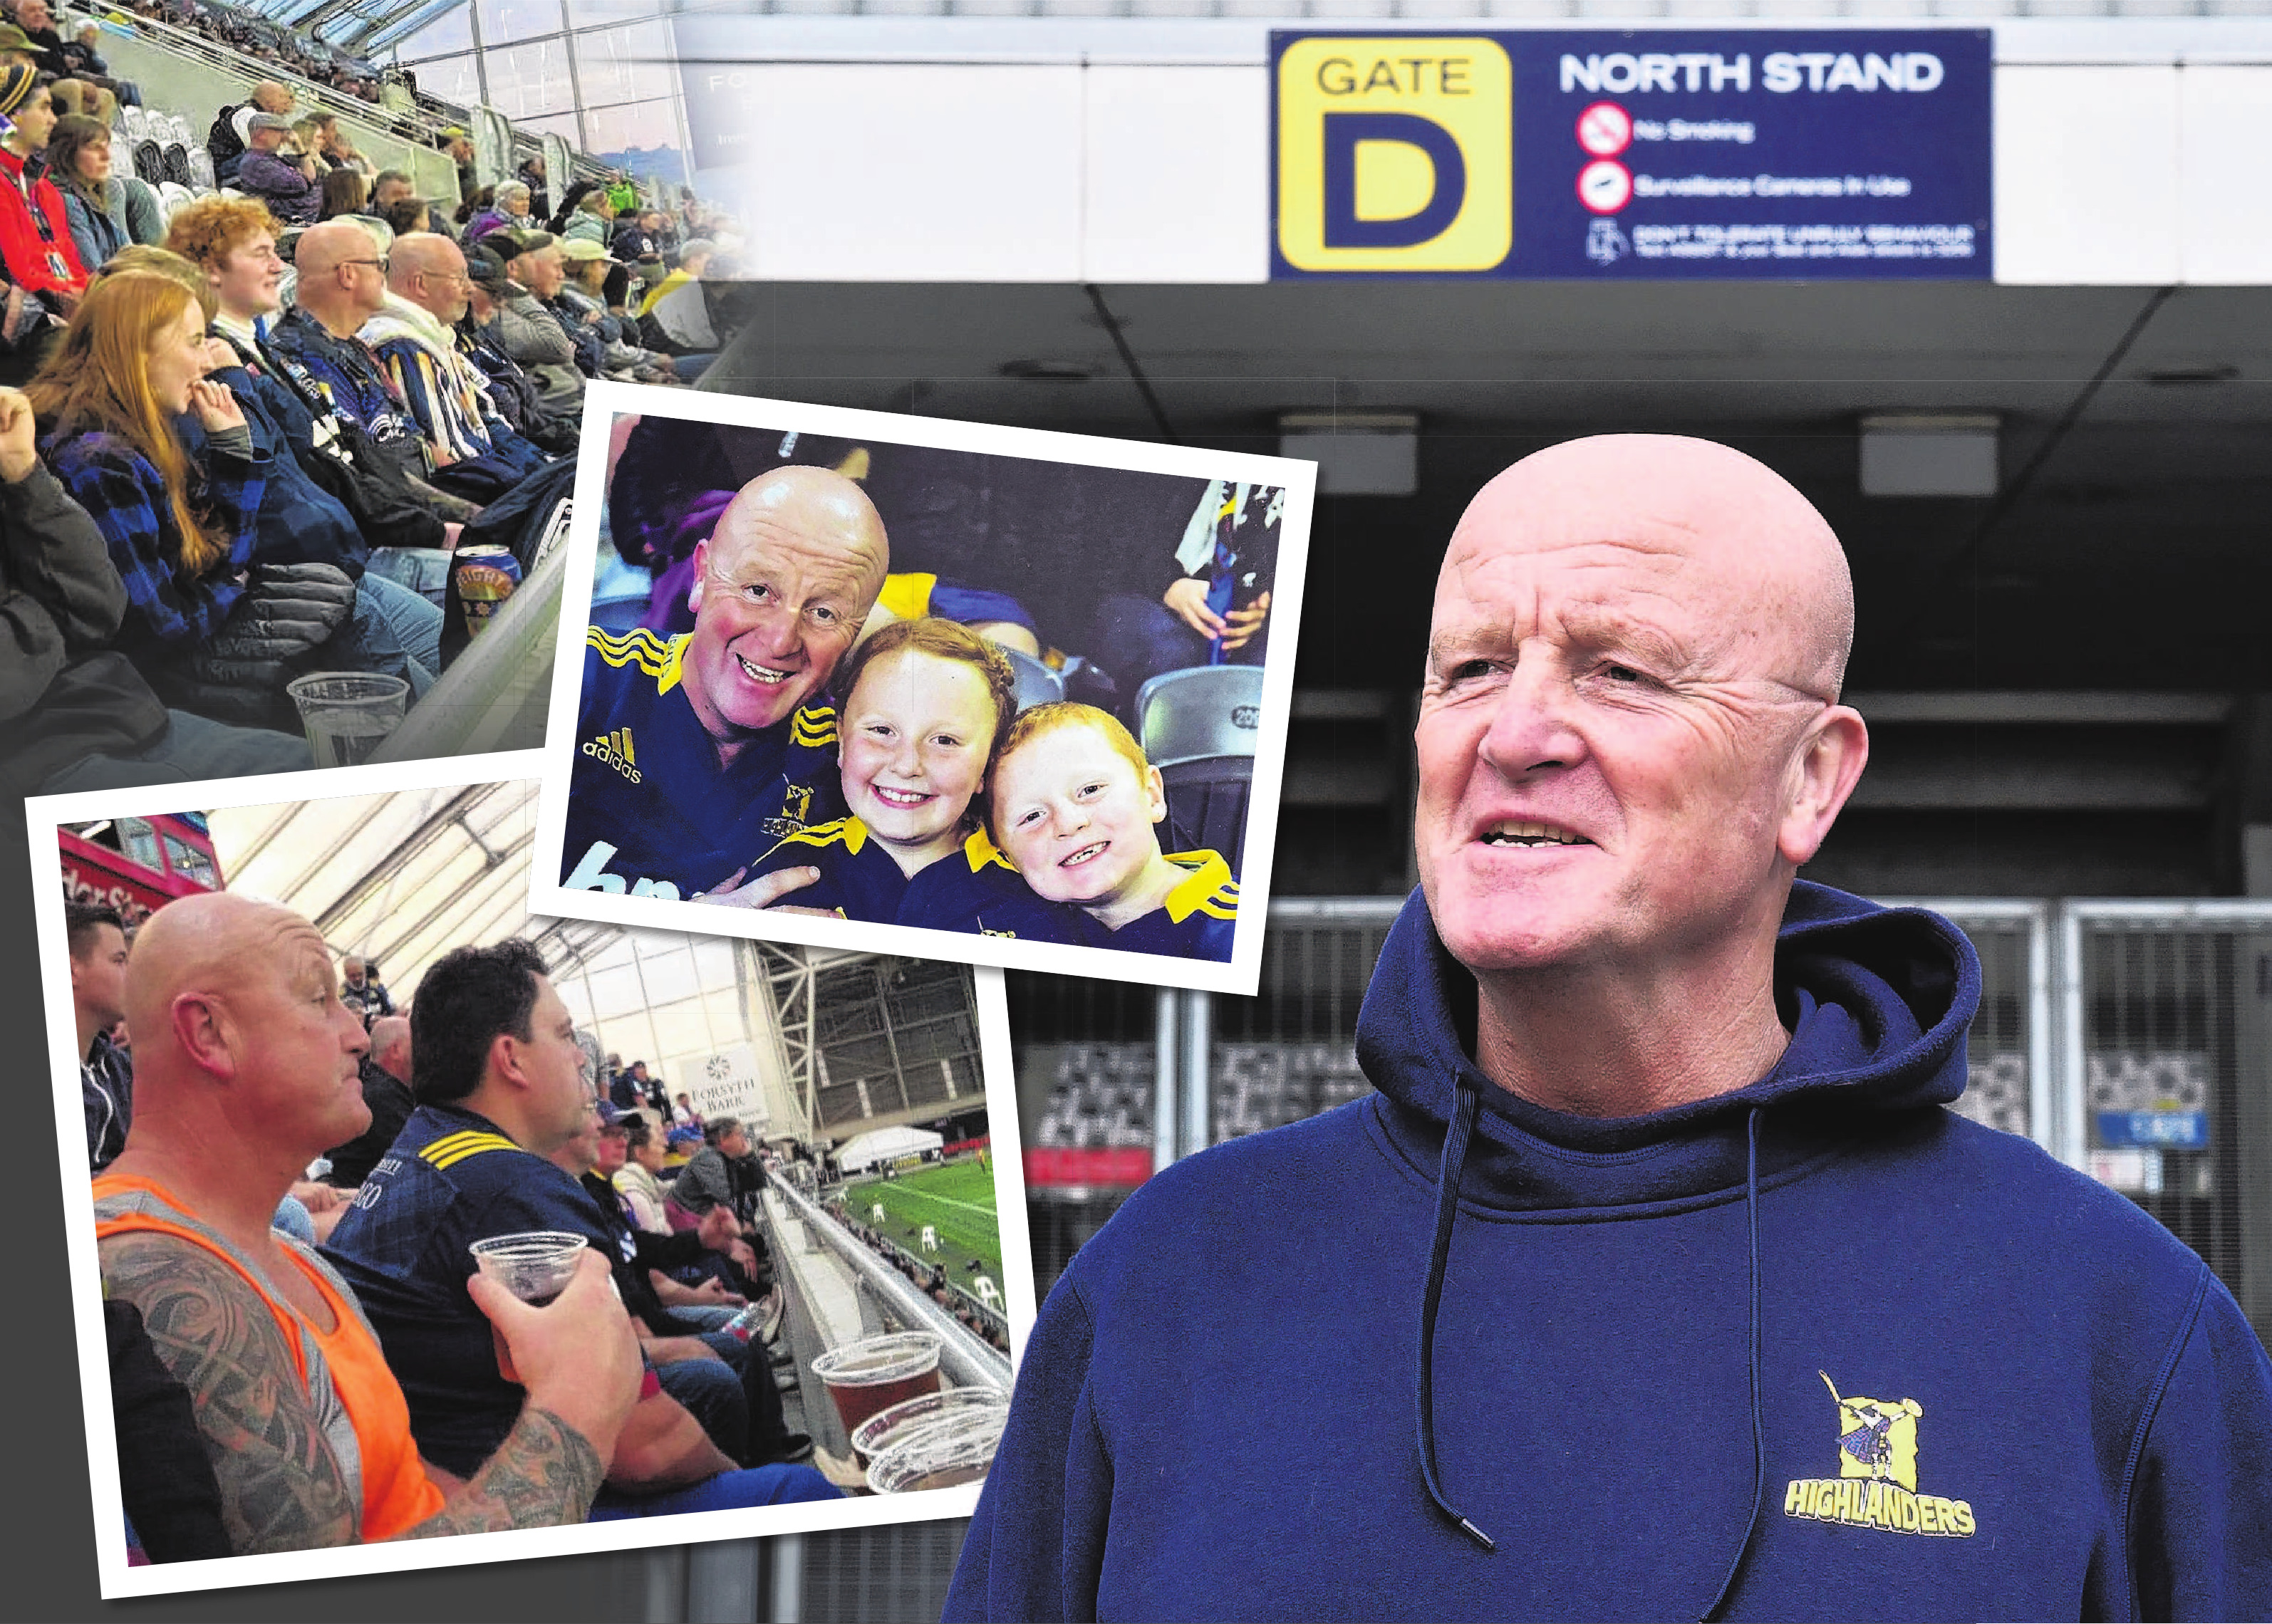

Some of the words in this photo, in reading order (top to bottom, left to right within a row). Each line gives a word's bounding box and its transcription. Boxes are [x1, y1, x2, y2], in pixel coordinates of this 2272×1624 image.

[1317, 57, 1471, 95] GATE
[1559, 52, 1751, 94] NORTH
[1760, 52, 1944, 94] STAND
[1634, 121, 1666, 142] No
[1668, 120, 1755, 144] Smoking
[1323, 112, 1467, 249] D
[1753, 175, 1843, 197] Cameras
[582, 741, 642, 784] adidas
[1785, 1479, 1976, 1539] HIGHLANDERS
